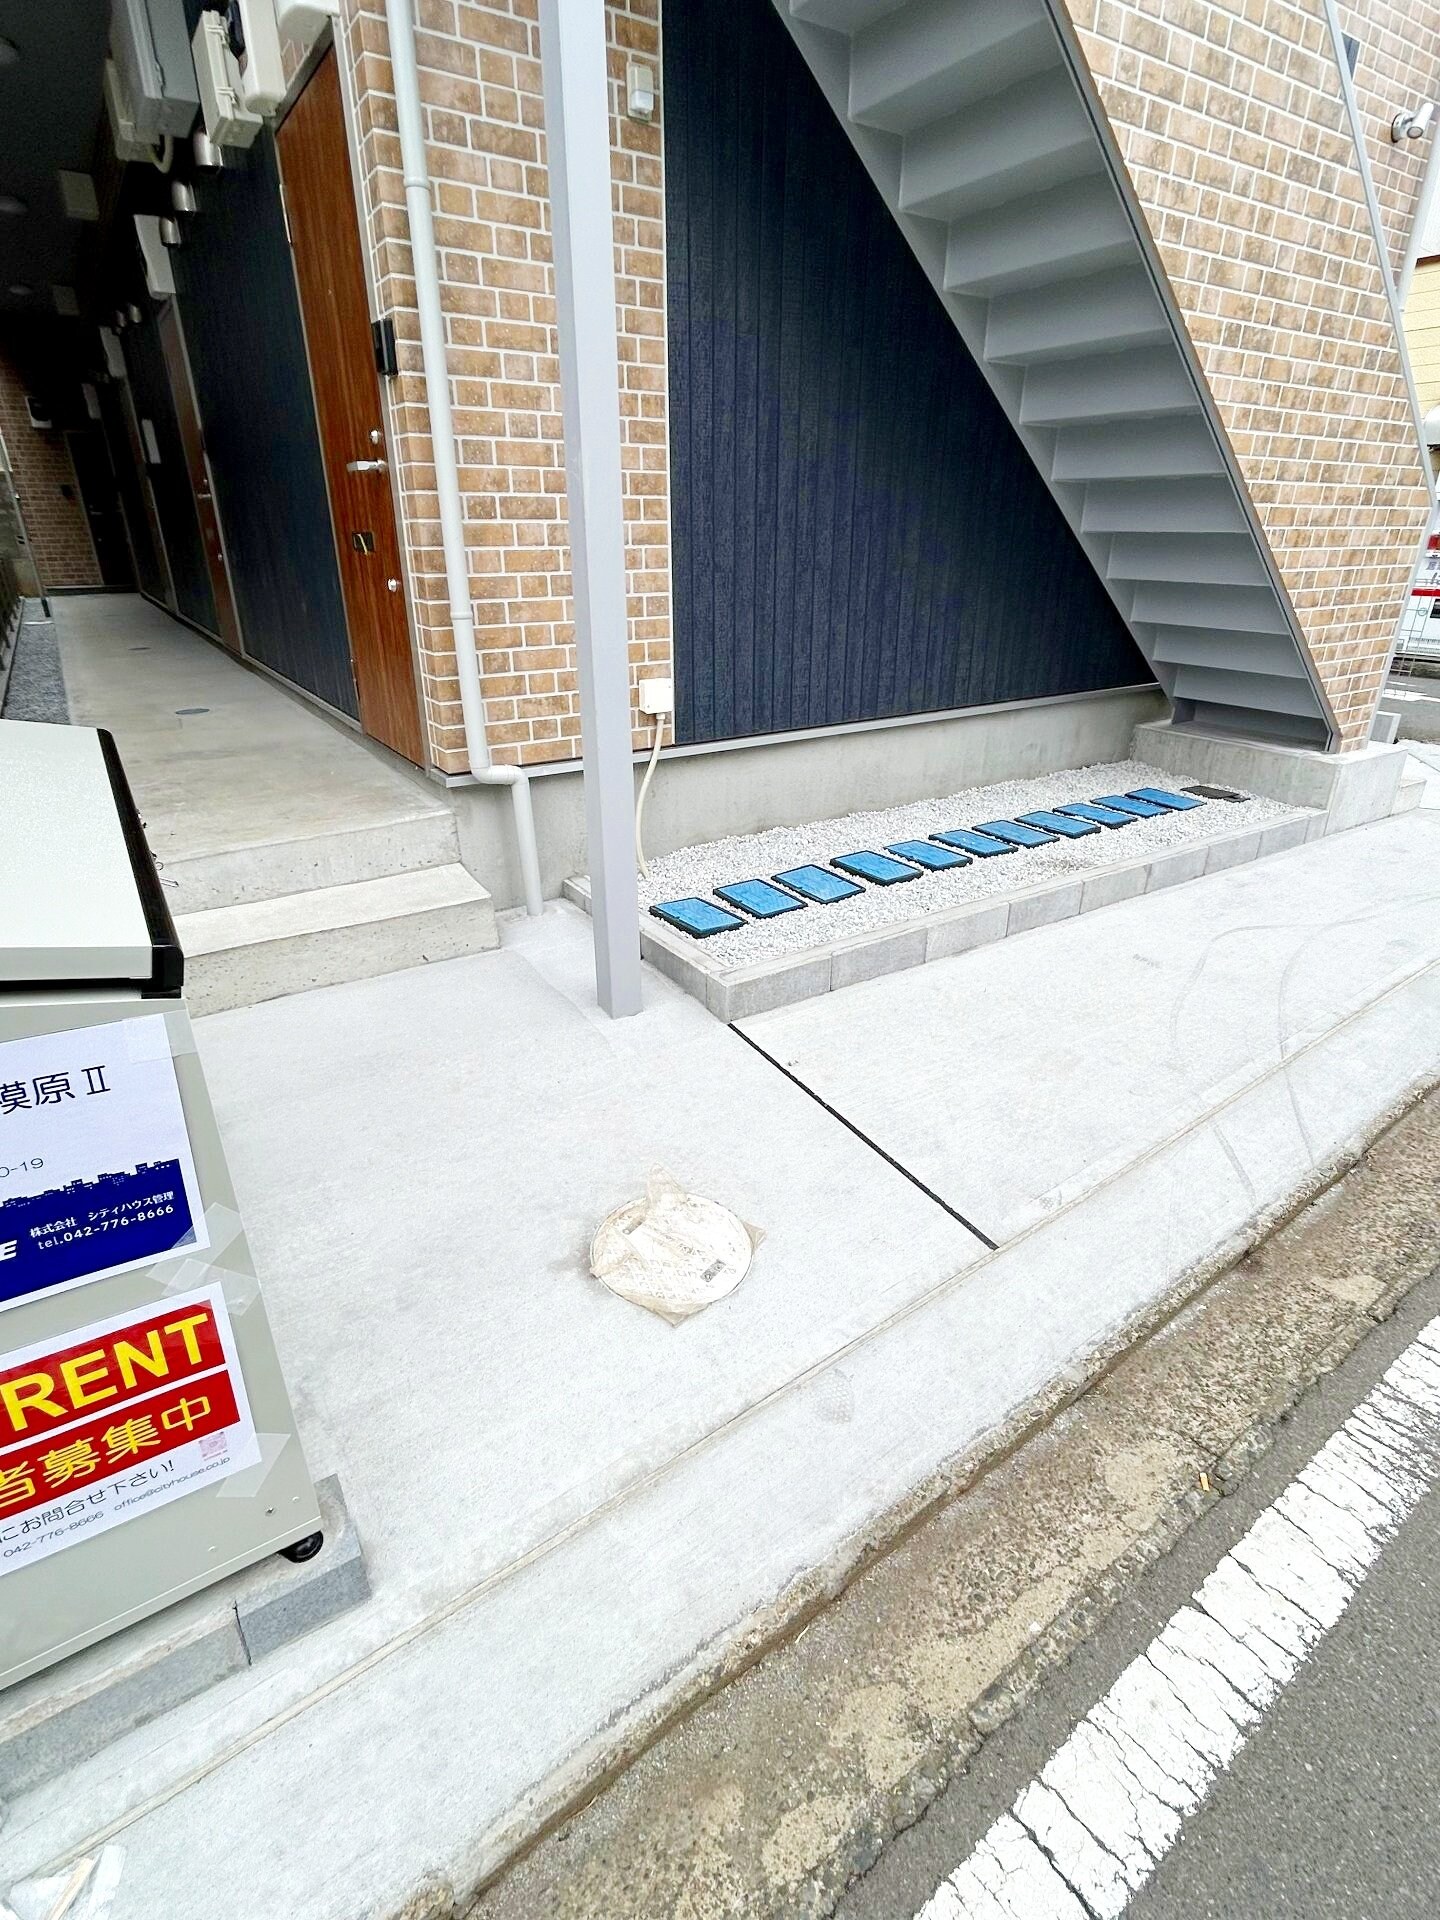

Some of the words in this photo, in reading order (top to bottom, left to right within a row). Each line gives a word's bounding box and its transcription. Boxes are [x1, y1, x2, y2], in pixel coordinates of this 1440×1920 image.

[30, 1217, 78, 1238] 株式会社
[88, 1191, 174, 1221] シティハウス管理
[38, 1204, 174, 1250] tel.042-776-8666
[0, 1313, 208, 1432] RENT
[3, 1510, 105, 1558] 042-776-8666
